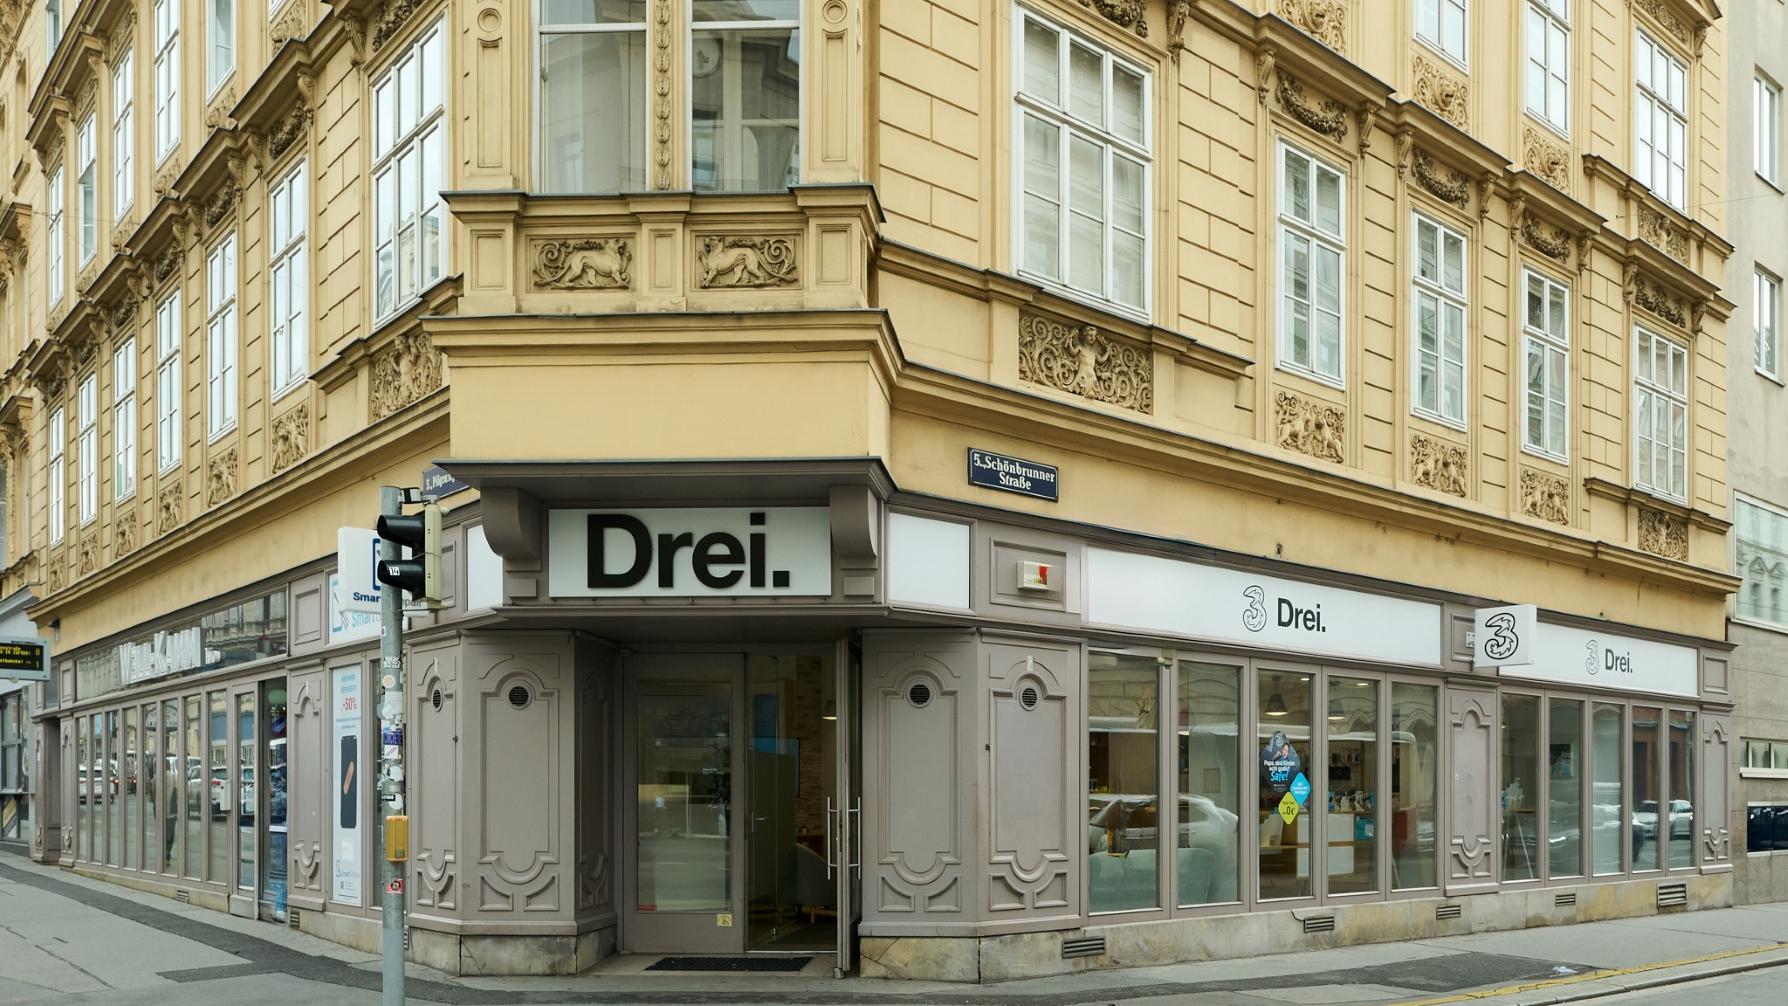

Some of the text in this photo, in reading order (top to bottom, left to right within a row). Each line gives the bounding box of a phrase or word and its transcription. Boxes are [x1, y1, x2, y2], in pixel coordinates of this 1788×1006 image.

[999, 472, 1032, 490] Straße
[587, 512, 790, 588] Drei.
[353, 592, 381, 603] Smar
[1277, 597, 1326, 632] Drei.
[1604, 648, 1633, 673] Drei.
